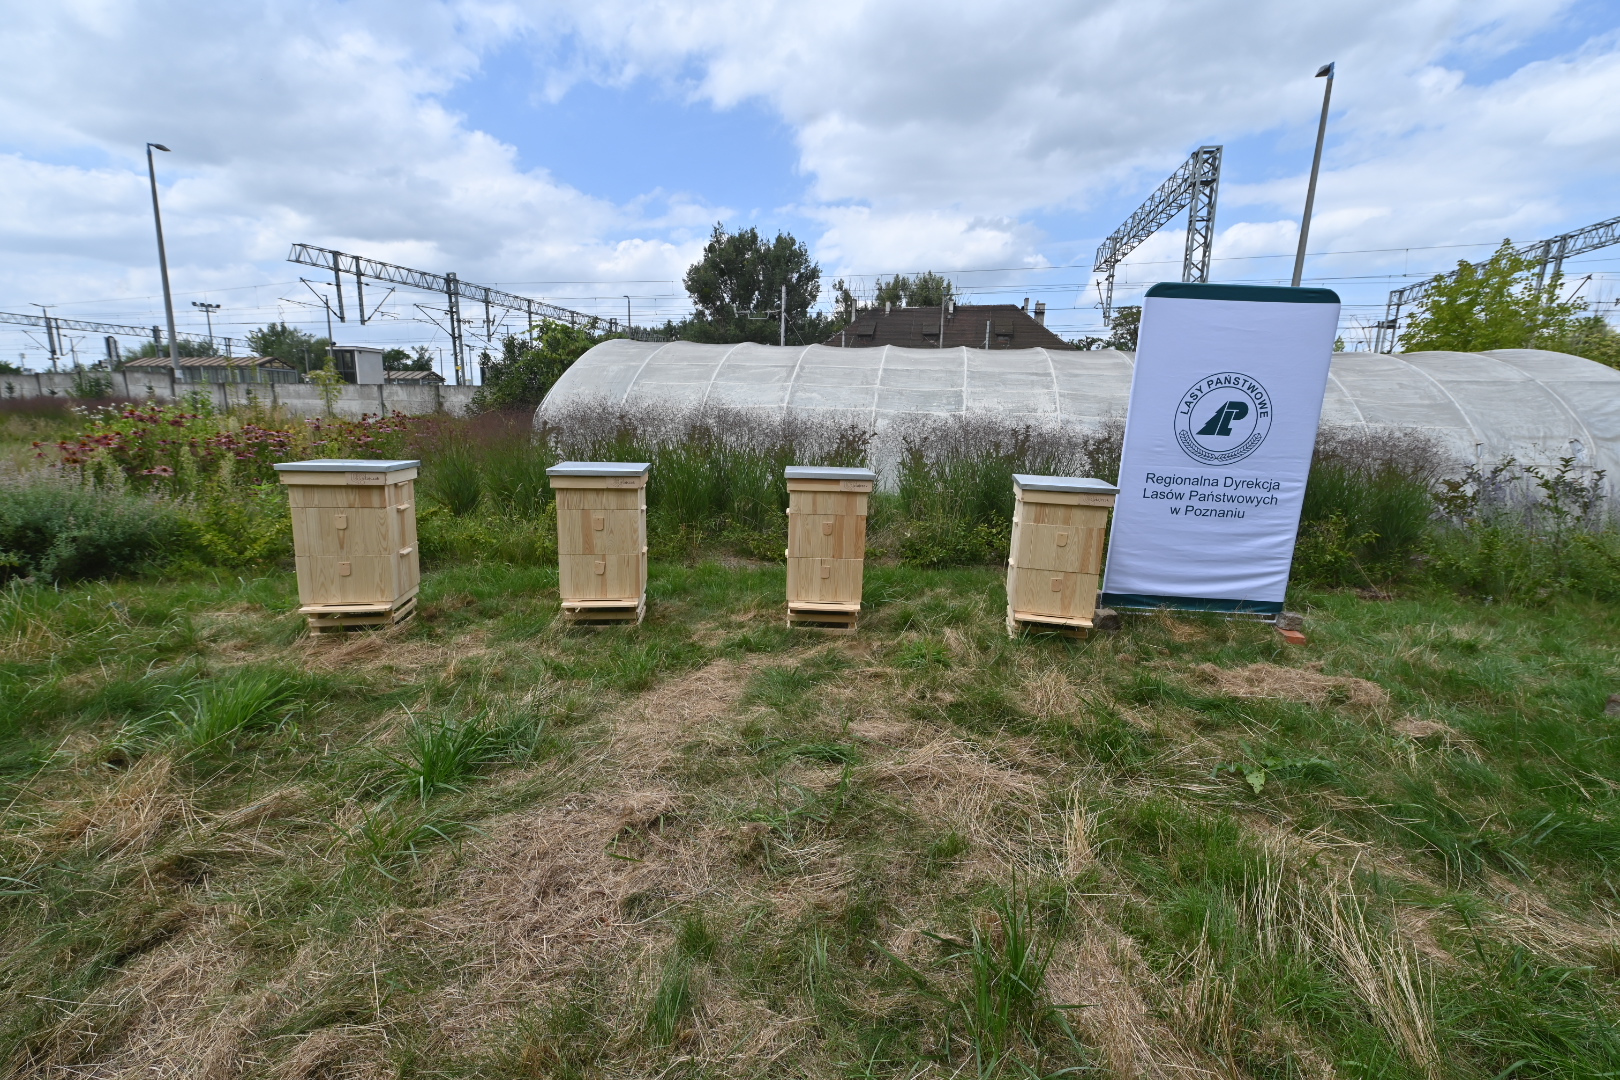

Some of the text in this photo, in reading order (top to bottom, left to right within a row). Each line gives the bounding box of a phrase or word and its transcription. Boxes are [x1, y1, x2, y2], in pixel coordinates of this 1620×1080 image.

[1180, 374, 1269, 419] LASY PAŃSTWOWE
[1145, 472, 1281, 493] Regionalna Dyrekcja
[1142, 488, 1279, 507] Lasów Państwowych
[1169, 504, 1246, 519] w Poznaniu
